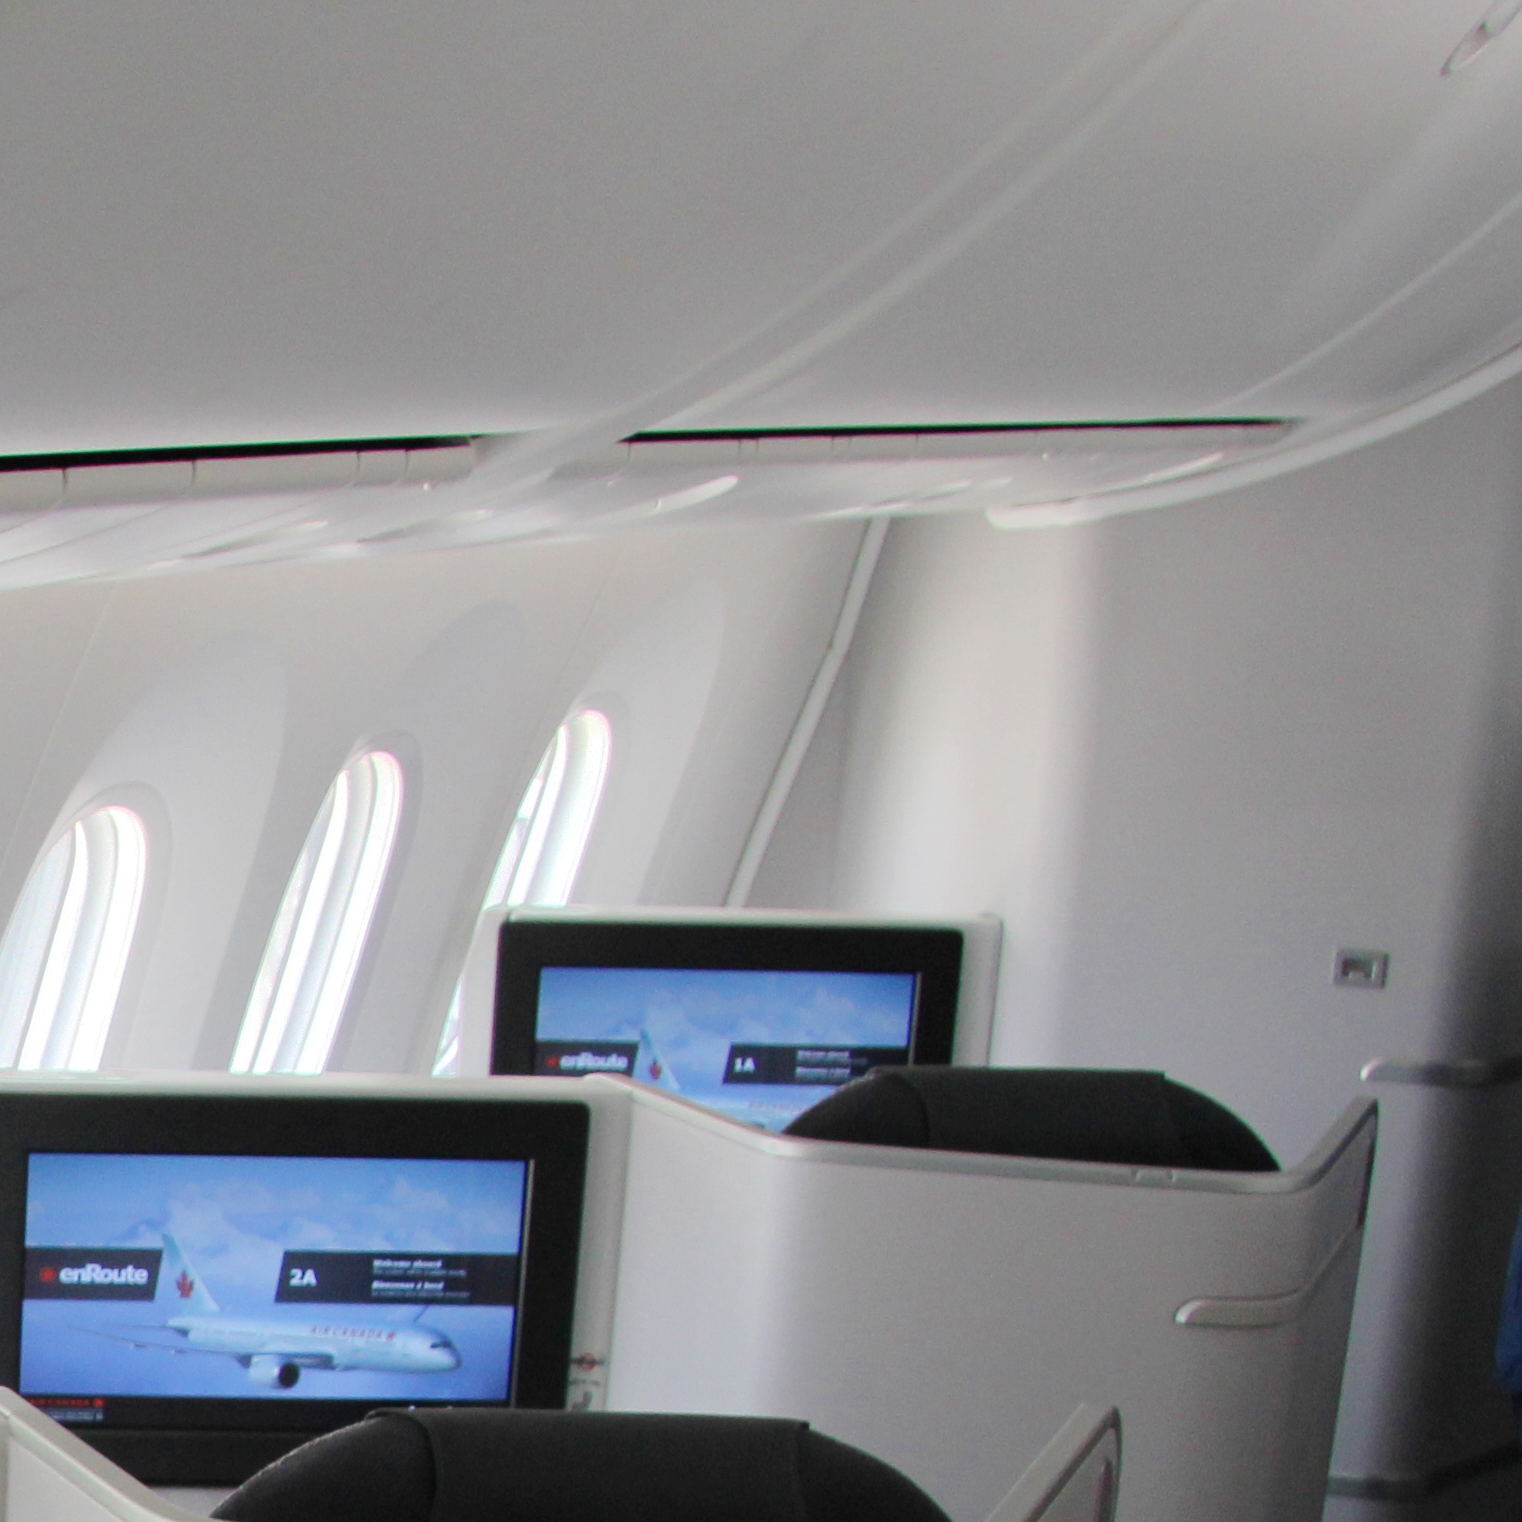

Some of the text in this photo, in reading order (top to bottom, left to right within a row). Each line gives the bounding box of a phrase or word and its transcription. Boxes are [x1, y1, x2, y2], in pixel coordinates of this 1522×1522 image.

[734, 1057, 756, 1072] 1A
[59, 1262, 149, 1285] enRoute
[289, 1268, 318, 1287] 2A
